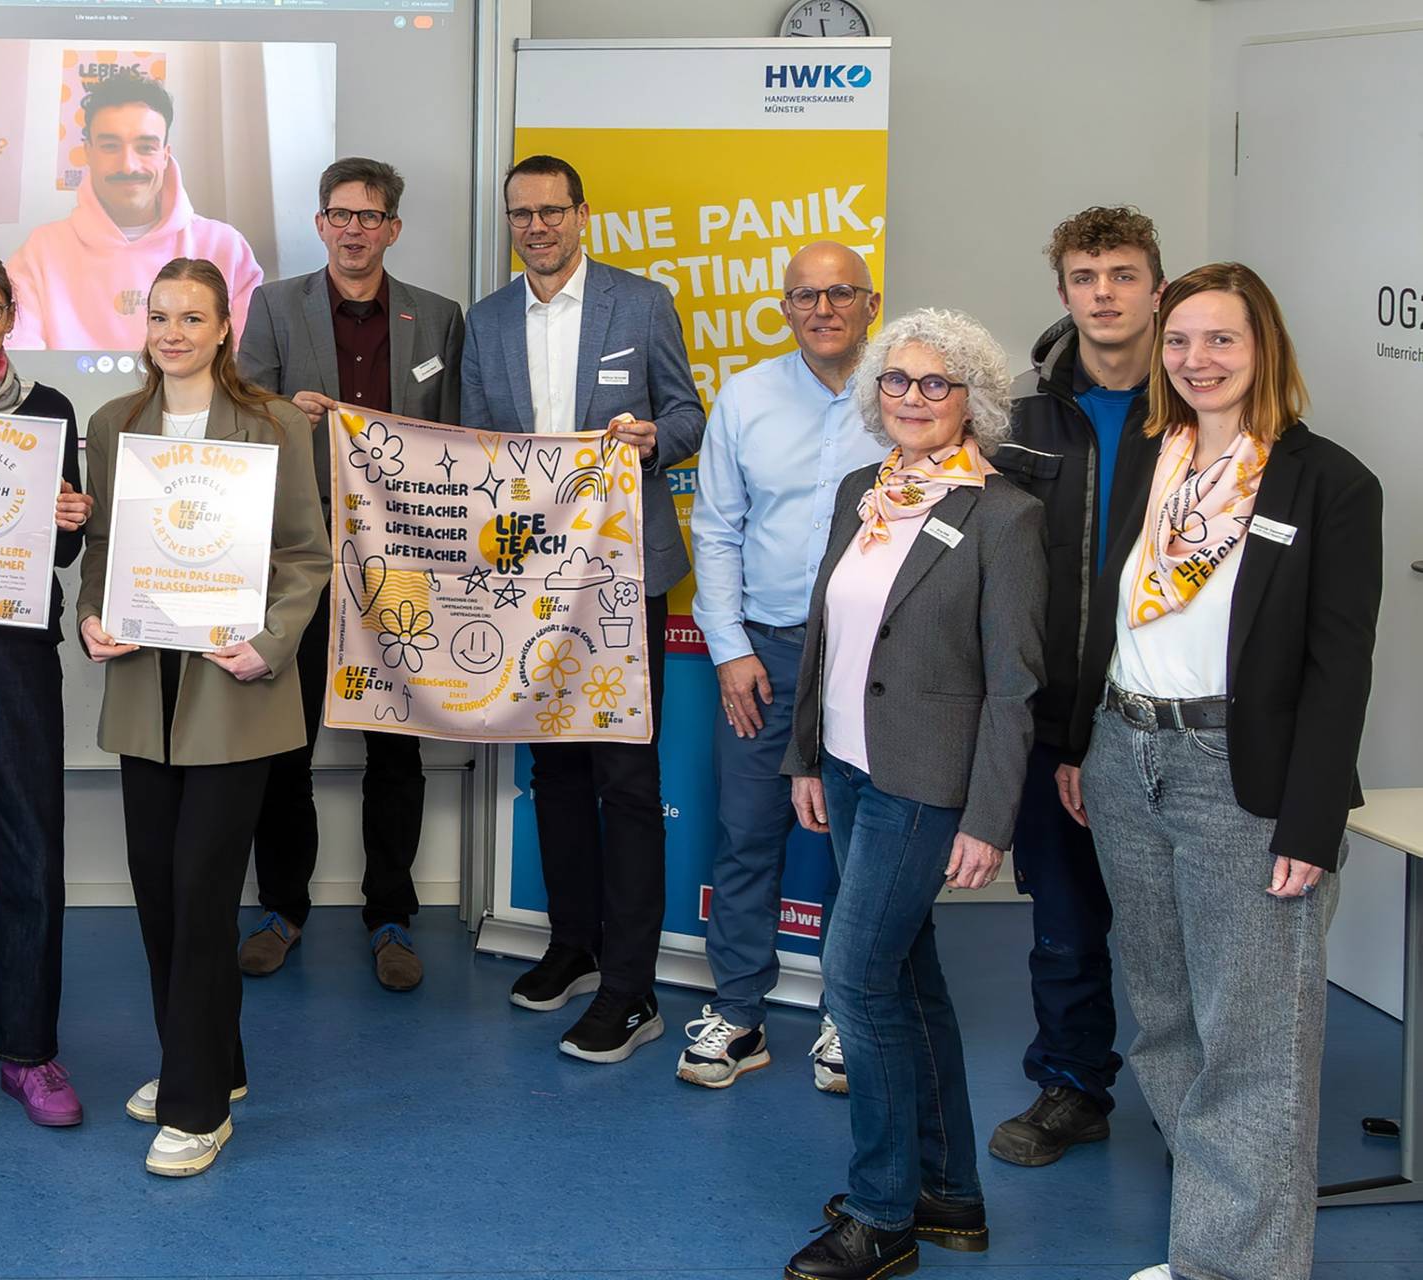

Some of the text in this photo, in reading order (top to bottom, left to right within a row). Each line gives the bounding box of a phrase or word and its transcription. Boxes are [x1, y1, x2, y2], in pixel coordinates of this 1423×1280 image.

[804, 7, 812, 16] 11
[820, 2, 830, 12] 12
[790, 19, 802, 29] 10
[849, 20, 857, 30] 2
[764, 95, 854, 103] HANDWERKSKAMMER
[764, 104, 805, 113] MÜNSTER
[699, 184, 885, 244] PANIK,
[1378, 286, 1423, 330] OG
[1376, 342, 1423, 362] Unterrich
[180, 500, 208, 511] LIFE
[179, 510, 221, 522] TEACH
[178, 520, 195, 530] US
[495, 535, 567, 555] TEACH
[0, 547, 32, 558] LEBEN
[496, 554, 524, 575] US
[1176, 547, 1213, 578] LIFE
[189, 570, 210, 581] DAS
[540, 596, 560, 604] LIFE
[540, 604, 569, 612] TEACH
[539, 612, 551, 620] US
[346, 666, 378, 678] LIFE
[346, 678, 393, 691] TEACH
[344, 690, 363, 700] US
